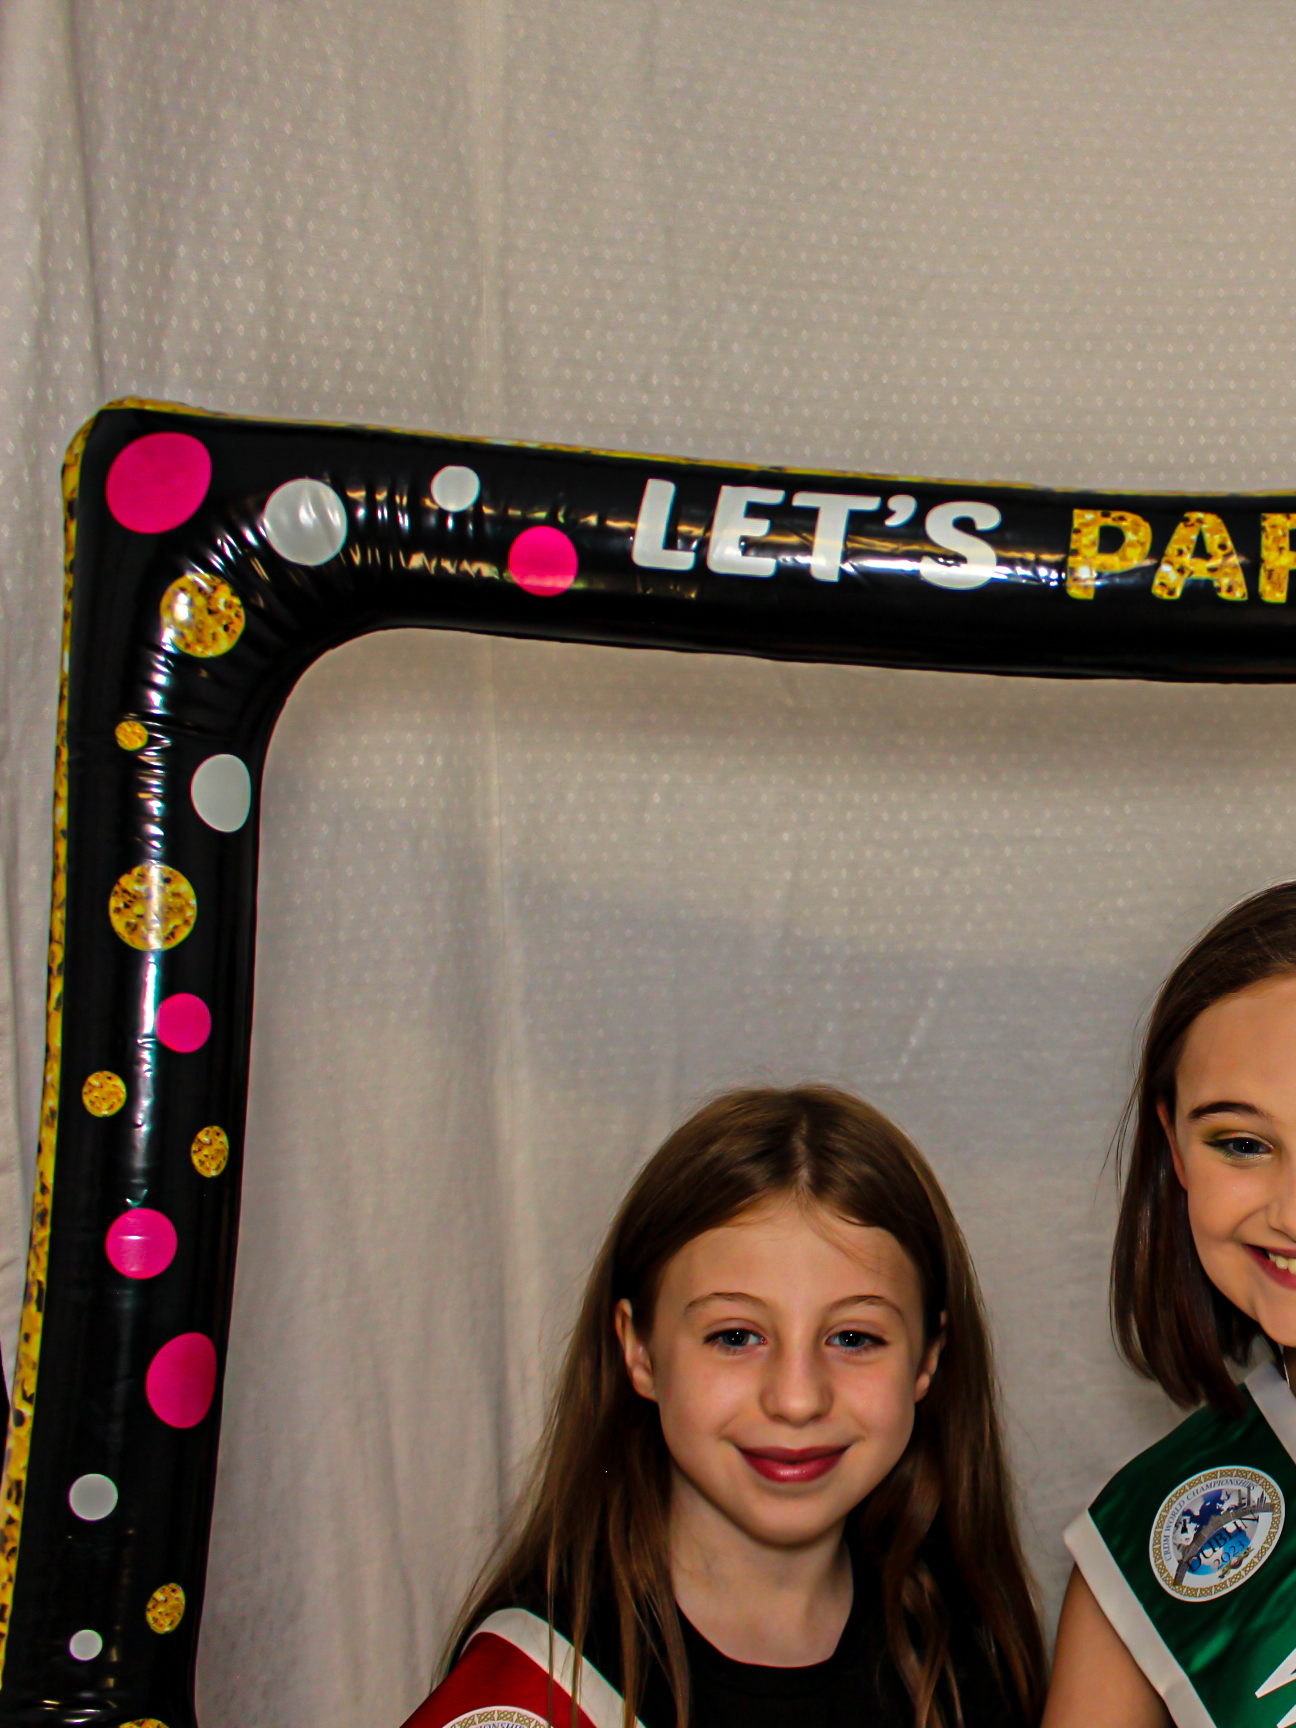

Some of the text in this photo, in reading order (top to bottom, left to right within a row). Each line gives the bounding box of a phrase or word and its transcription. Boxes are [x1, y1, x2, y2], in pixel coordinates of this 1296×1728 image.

[631, 478, 1002, 591] LET’S
[1162, 1478, 1258, 1562] CRDM WORLD CHAMPIONSHIPS
[1187, 1509, 1260, 1574] DUBLIN
[1213, 1540, 1246, 1570] 2023
